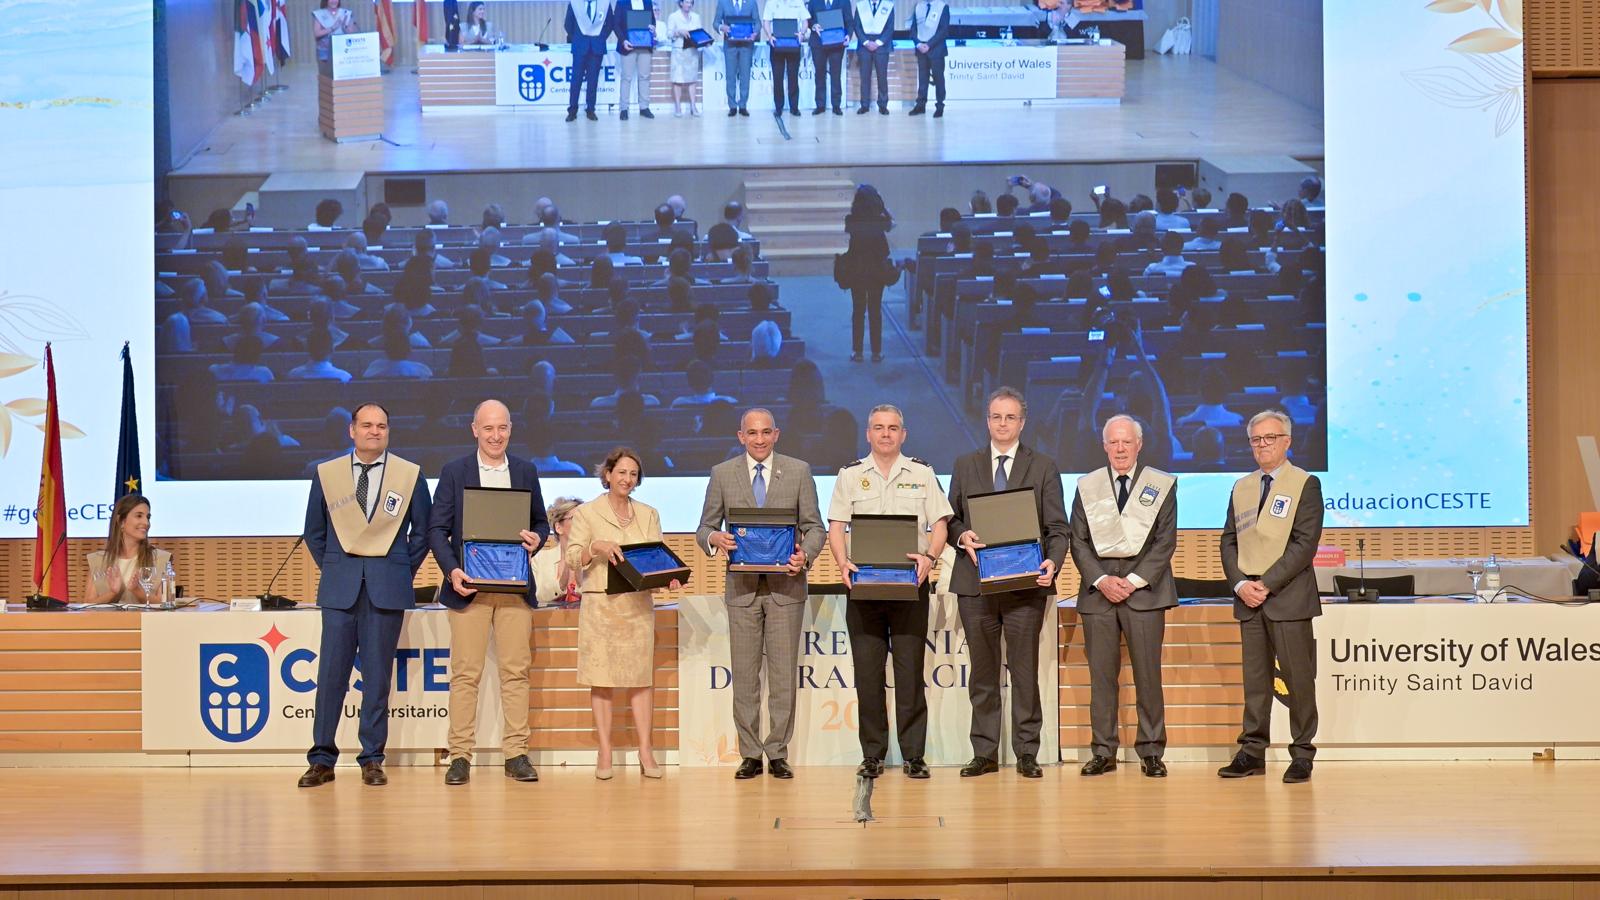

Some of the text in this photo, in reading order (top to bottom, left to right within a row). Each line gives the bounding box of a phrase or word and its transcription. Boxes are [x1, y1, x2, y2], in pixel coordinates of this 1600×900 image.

[949, 59, 1052, 71] University of Wales
[1324, 492, 1492, 511] aduacionCESTE
[1330, 637, 1600, 668] University of Wales
[280, 648, 450, 693] CTE
[1331, 673, 1534, 696] Trinity Saint David
[344, 703, 449, 719] Ursitario
